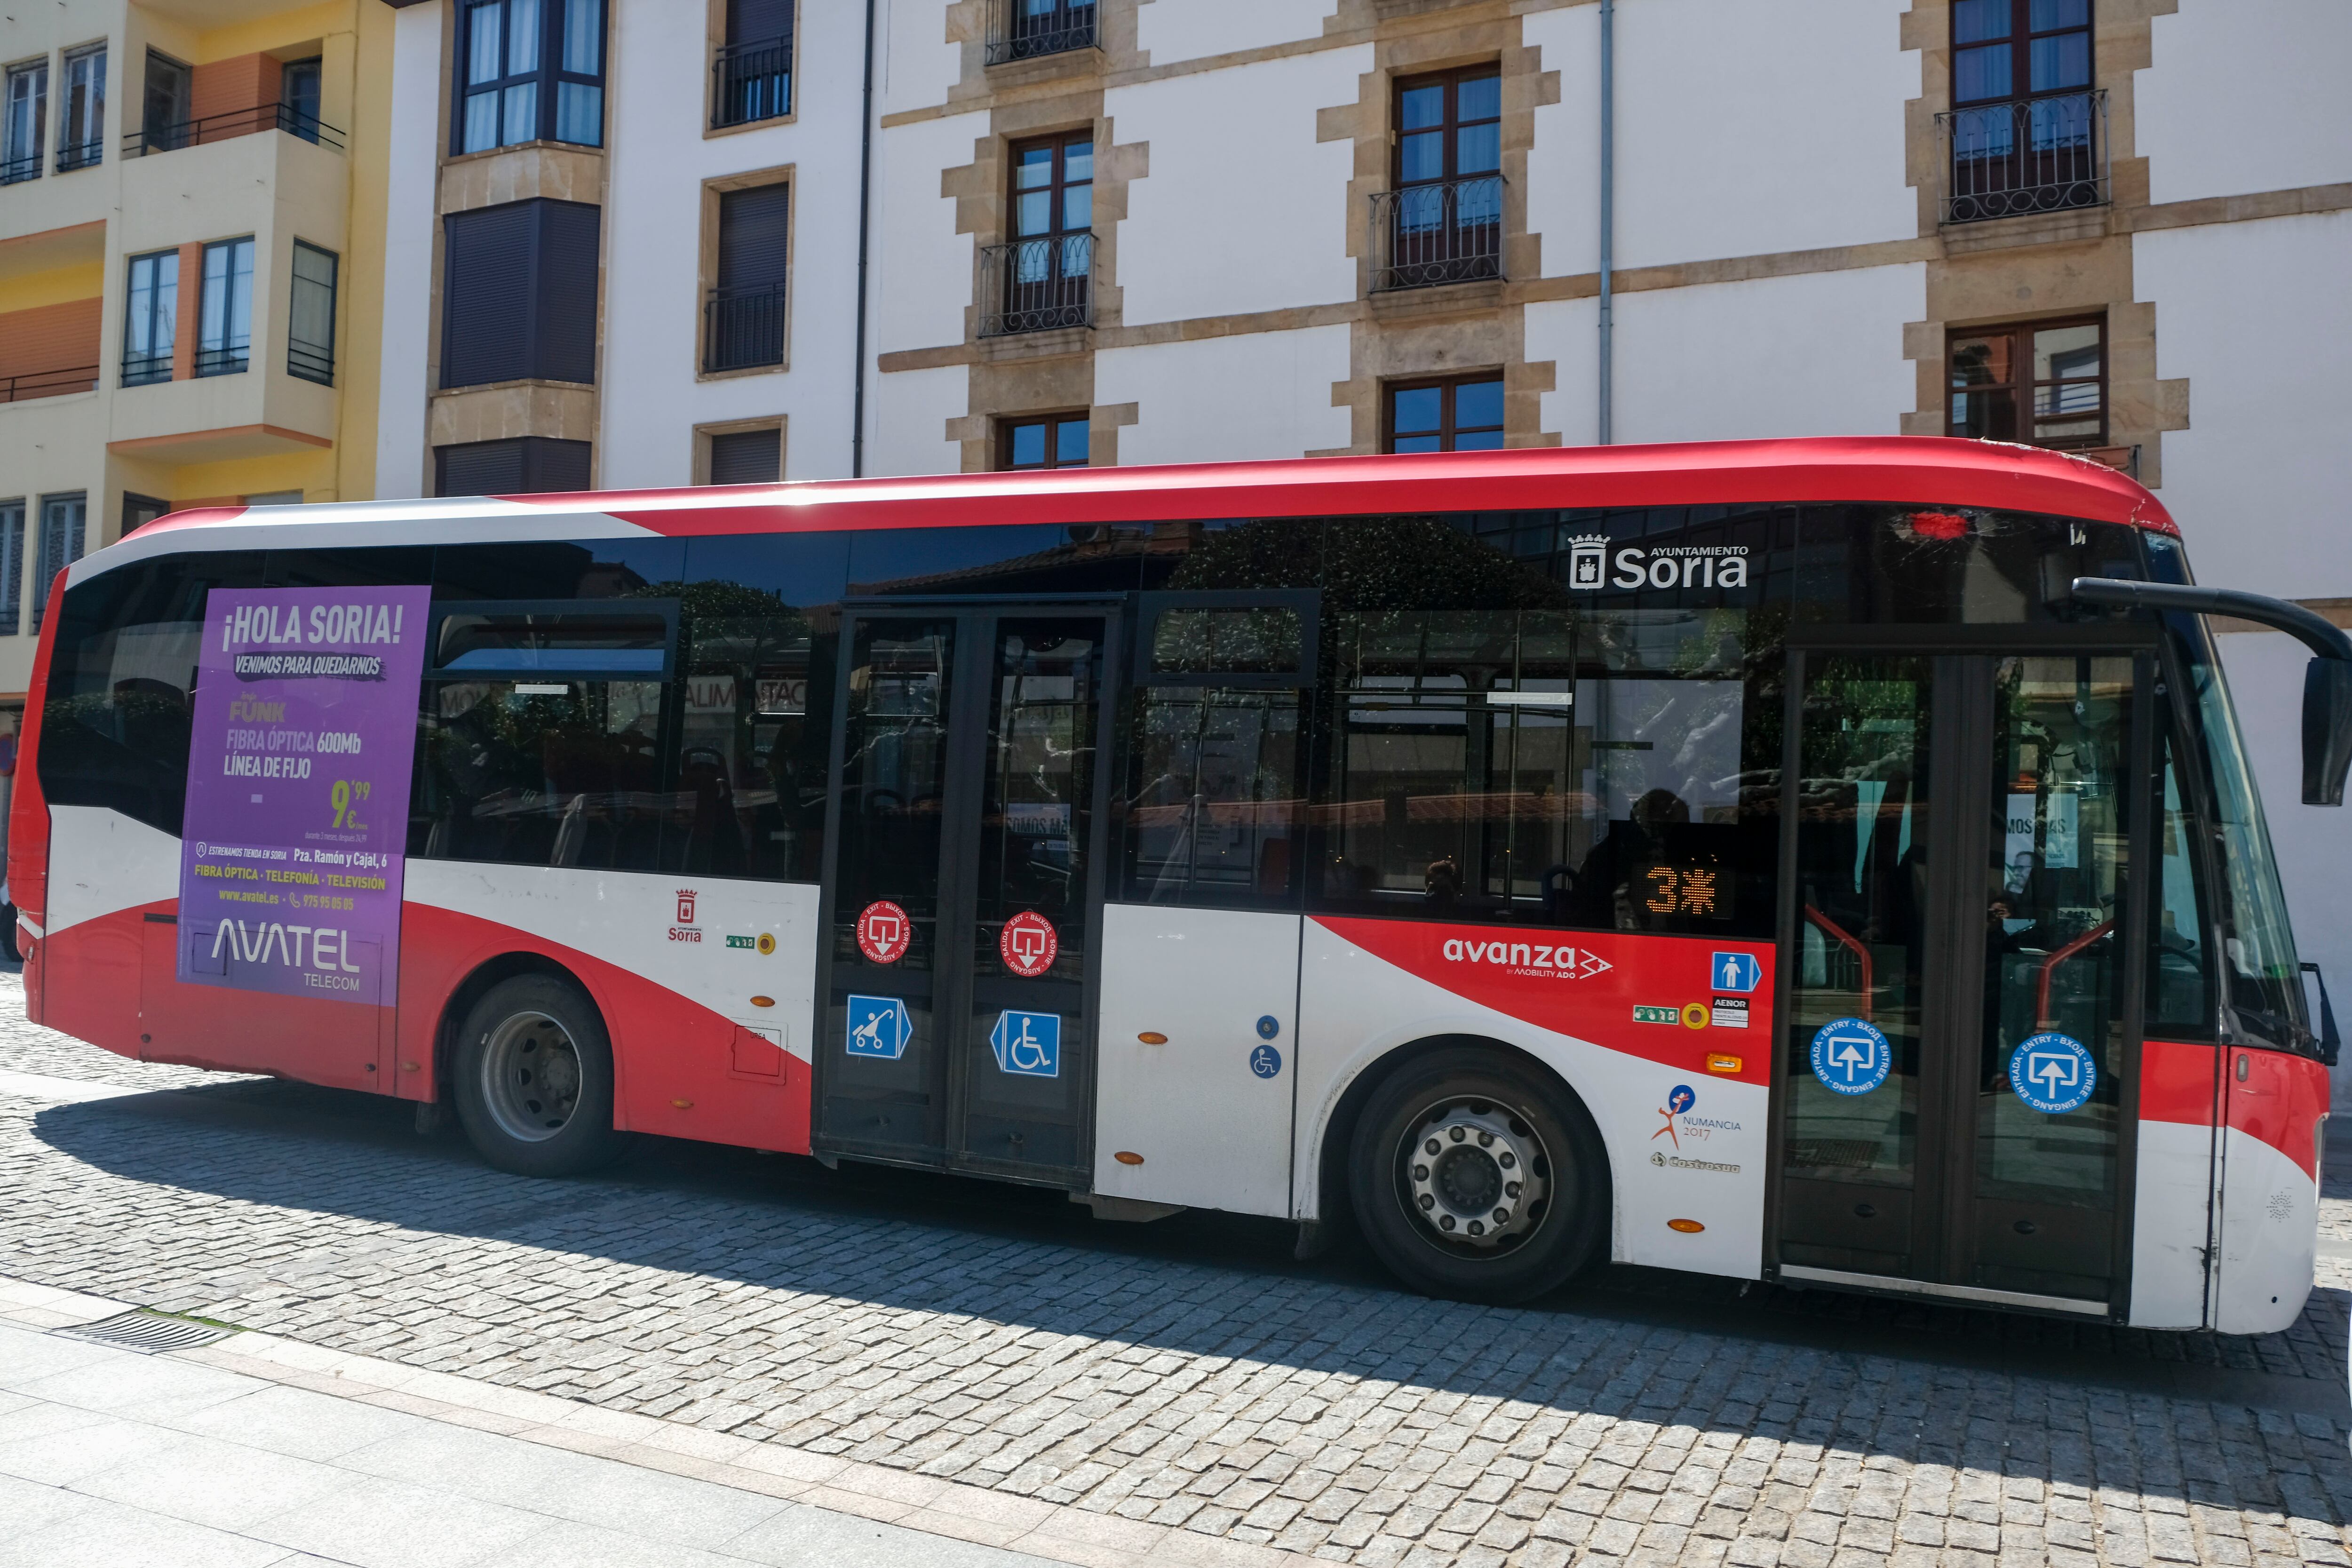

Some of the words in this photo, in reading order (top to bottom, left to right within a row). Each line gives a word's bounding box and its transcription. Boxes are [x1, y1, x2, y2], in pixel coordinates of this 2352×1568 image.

[1650, 546, 1749, 557] AYUNTAMIENTO
[1613, 548, 1748, 588] Soria
[222, 605, 301, 652] ¡HOLA
[308, 605, 403, 644] SORIA!
[235, 656, 282, 674] VENIMOS
[282, 656, 311, 674] PARA
[313, 656, 381, 675] QUEDARNOS
[229, 701, 286, 723] FUNK
[226, 729, 265, 750] FIBRA
[267, 725, 315, 752] ÓPTICA
[317, 732, 361, 754] 600Mb
[223, 750, 261, 777] LÍNEA
[263, 757, 281, 778] DE
[282, 757, 311, 779] FIJO
[208, 846, 243, 857] ESTRENAMOS
[243, 848, 262, 858] TIENDA
[262, 850, 270, 859] EN
[270, 851, 286, 860] SORIA
[294, 848, 312, 862] Pza.
[314, 850, 344, 864] Ramón
[346, 854, 352, 868] y
[353, 852, 379, 869] Cajal,
[381, 854, 387, 867] 6
[195, 864, 222, 877] FIBRA
[224, 863, 258, 880] ÓPTICA
[266, 869, 319, 885] TELEFONÍA
[327, 874, 386, 890] TELEVISIÓN
[219, 890, 279, 904] www.avatel.es
[303, 895, 318, 907] 975
[320, 896, 330, 908] 95
[332, 897, 342, 909] 05
[343, 898, 354, 910] 05
[866, 904, 879, 915] EXIT
[1010, 915, 1023, 926] EXIT
[668, 927, 701, 942] Soria
[899, 927, 909, 951] SORTIE
[211, 918, 360, 973] AVATEL
[866, 949, 895, 961] AUSGANG
[1044, 939, 1055, 965] SORTIE
[1443, 939, 1577, 969] avanza
[1010, 961, 1041, 974] AUSGANG
[1514, 968, 1555, 978] MOBILITY
[304, 973, 360, 992] TELECOM
[1714, 999, 1746, 1008] AENOR
[1822, 1020, 1850, 1037] ENTRY
[2022, 1035, 2052, 1052] ENTRY
[1813, 1041, 1830, 1081] ENTRADA
[1875, 1045, 1890, 1080] ENTREE
[1832, 1081, 1875, 1092] EINGANG
[2011, 1057, 2030, 1098] ENTRADA
[2080, 1061, 2094, 1098] ENTREE
[2033, 1098, 2078, 1111] EINGANG
[1683, 1116, 1741, 1130] NUMANCIA
[1684, 1128, 1711, 1141] 2017
